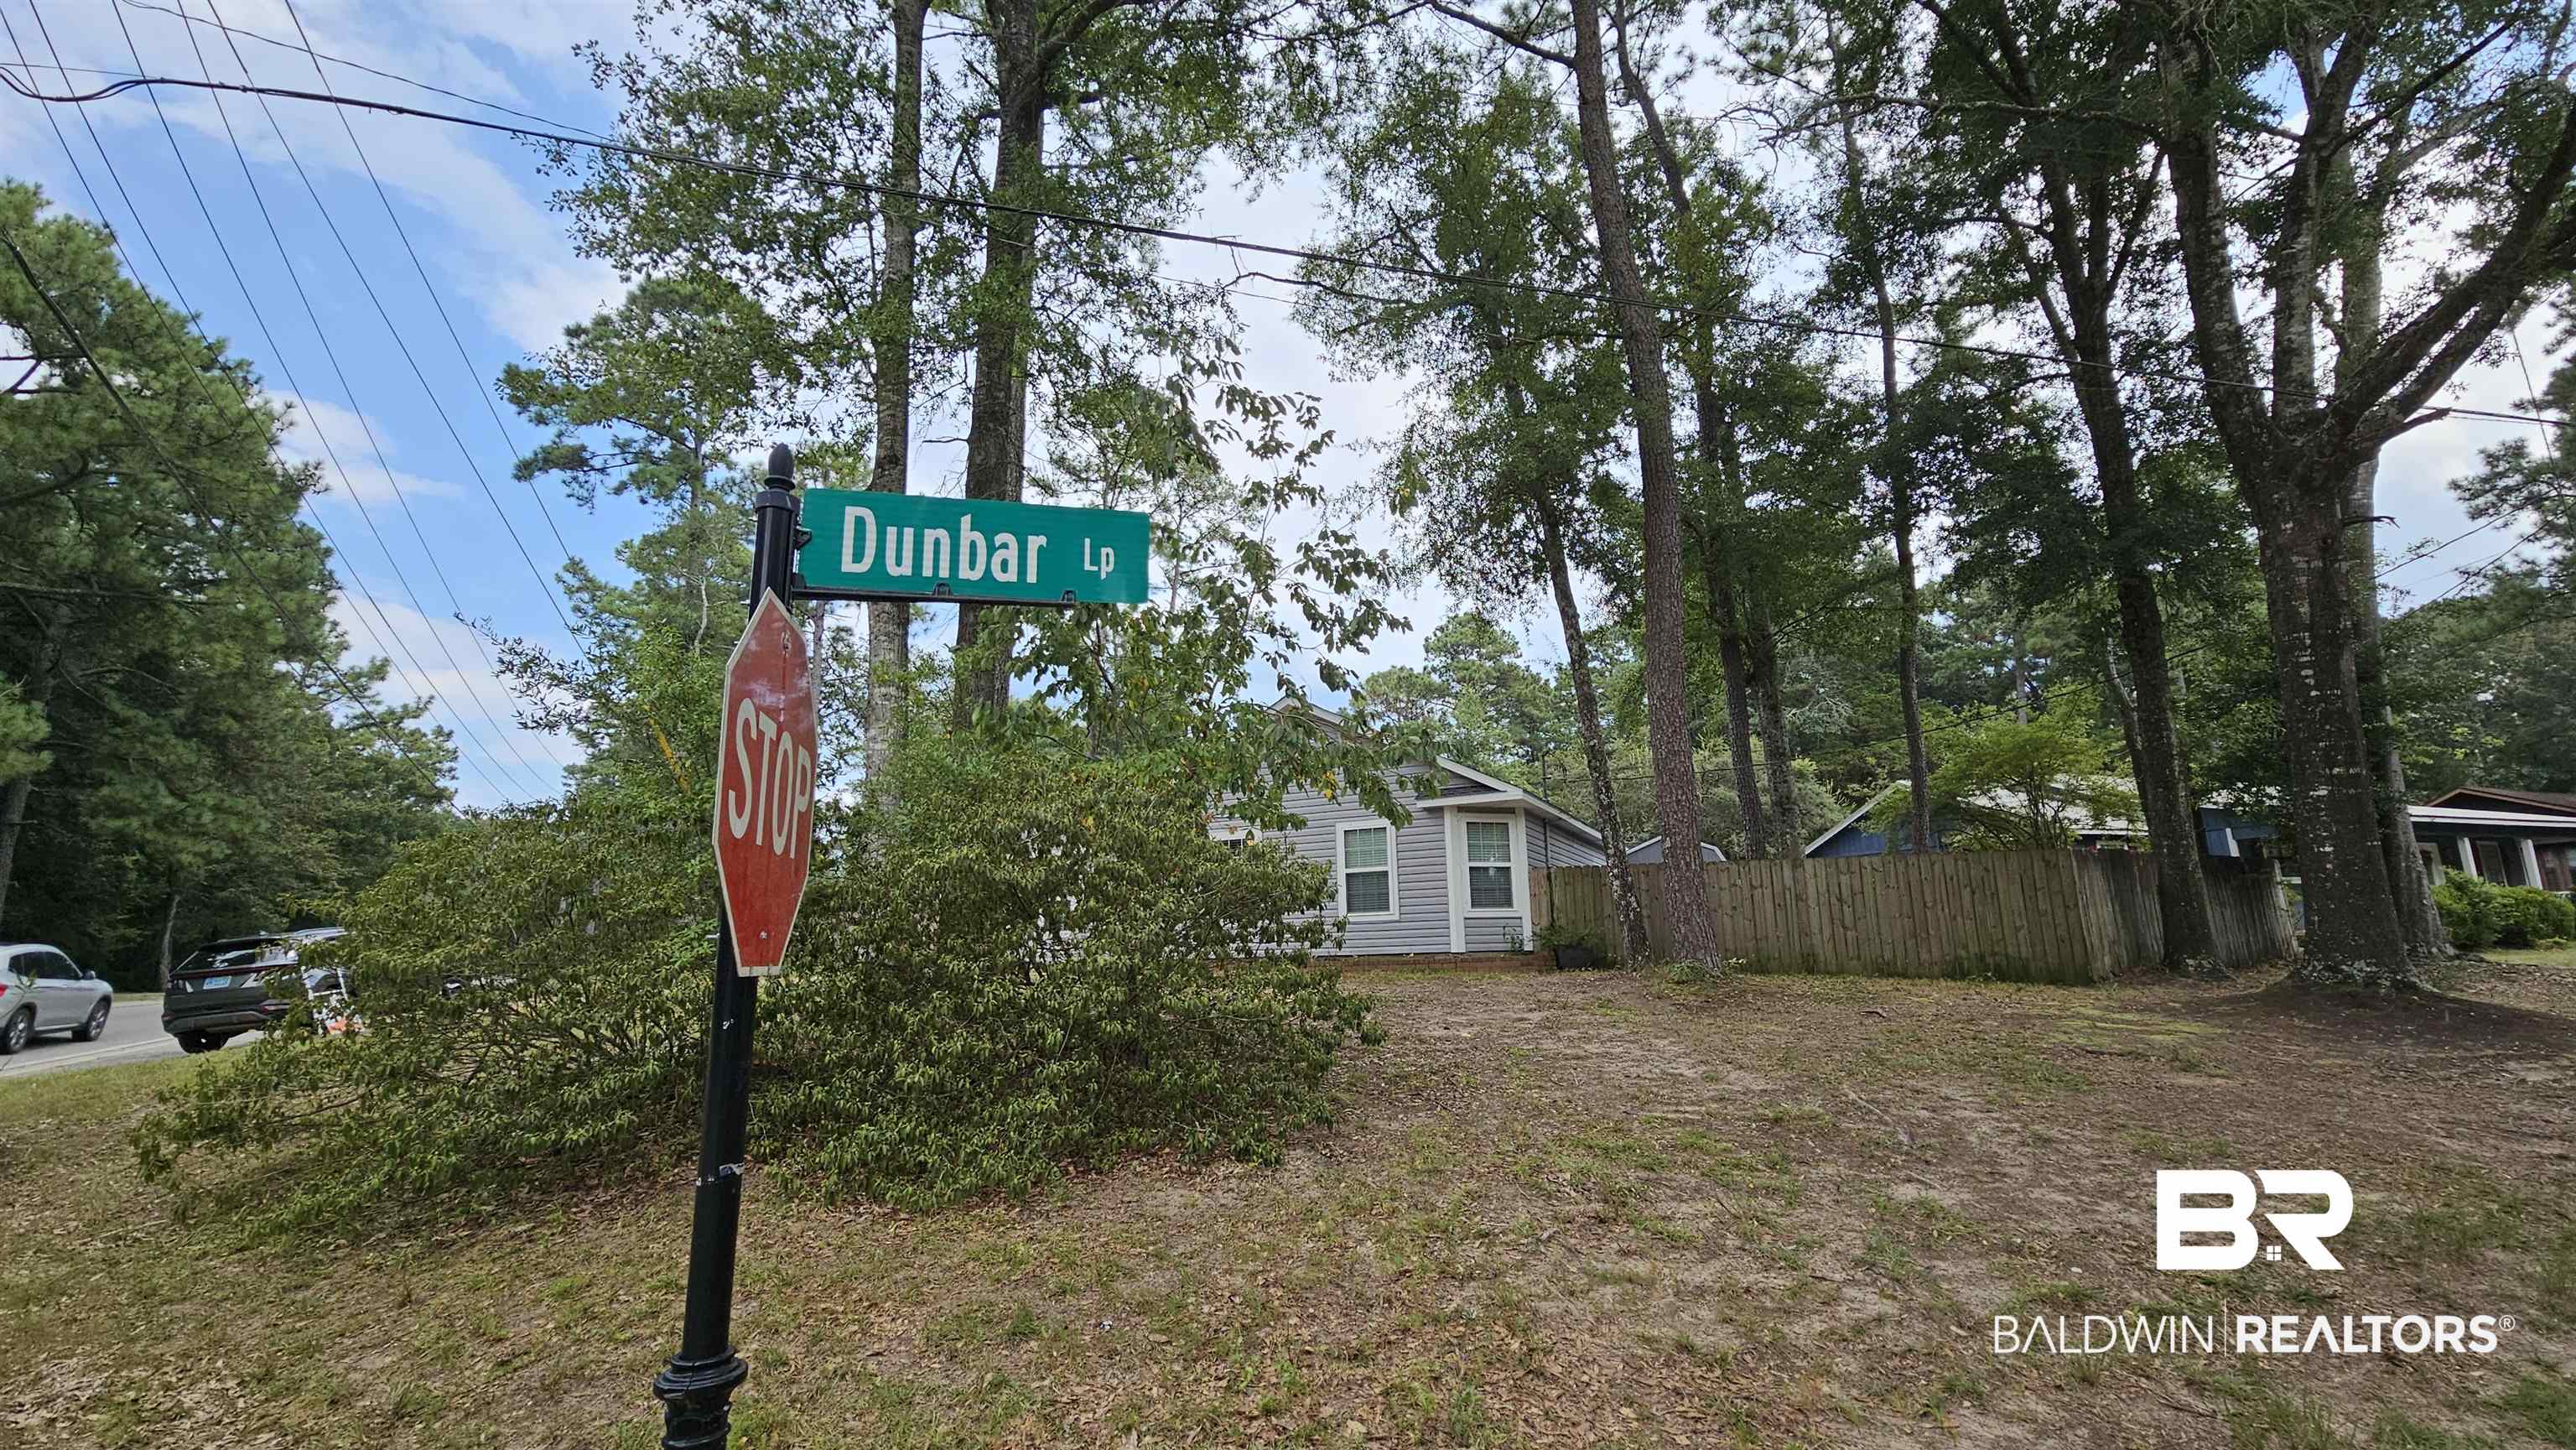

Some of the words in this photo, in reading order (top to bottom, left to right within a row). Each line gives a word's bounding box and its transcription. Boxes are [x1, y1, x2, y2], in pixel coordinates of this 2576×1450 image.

[841, 505, 1047, 584] Dunbar
[1083, 537, 1115, 579] Lp
[728, 697, 812, 860] STOP
